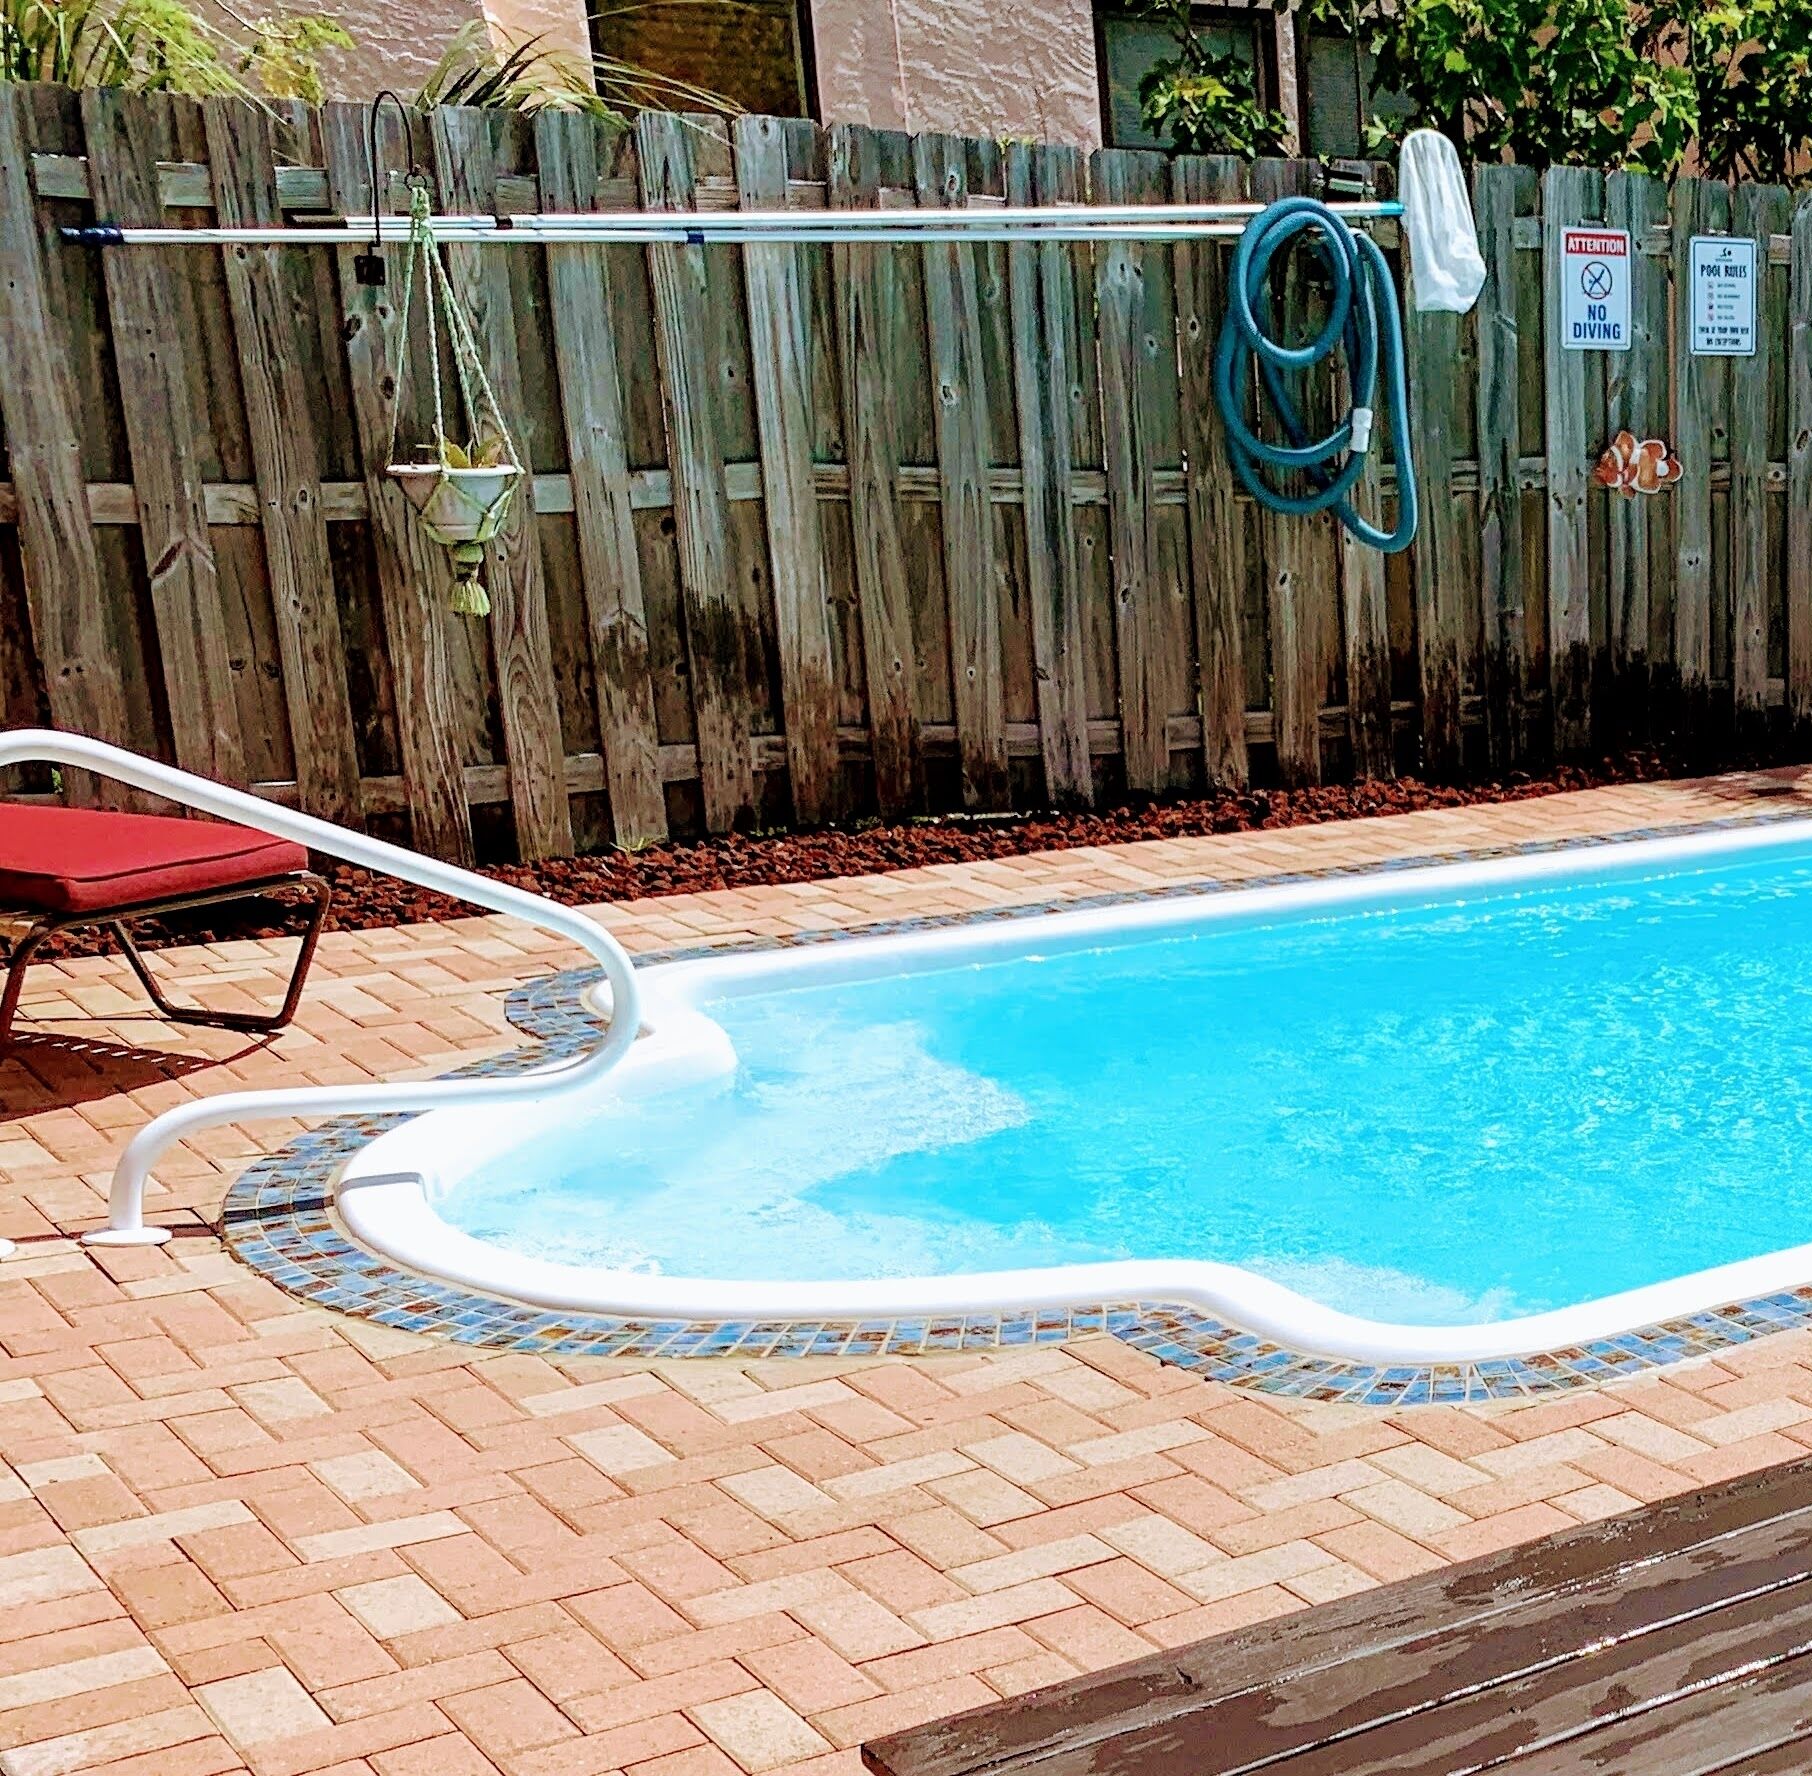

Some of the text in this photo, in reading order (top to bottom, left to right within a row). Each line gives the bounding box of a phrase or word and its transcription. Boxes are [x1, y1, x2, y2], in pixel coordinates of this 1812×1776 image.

[1568, 236, 1624, 253] ATTENTION
[1701, 264, 1746, 278] POOL RULES
[1588, 304, 1606, 321] NO
[1573, 322, 1620, 339] DIVING
